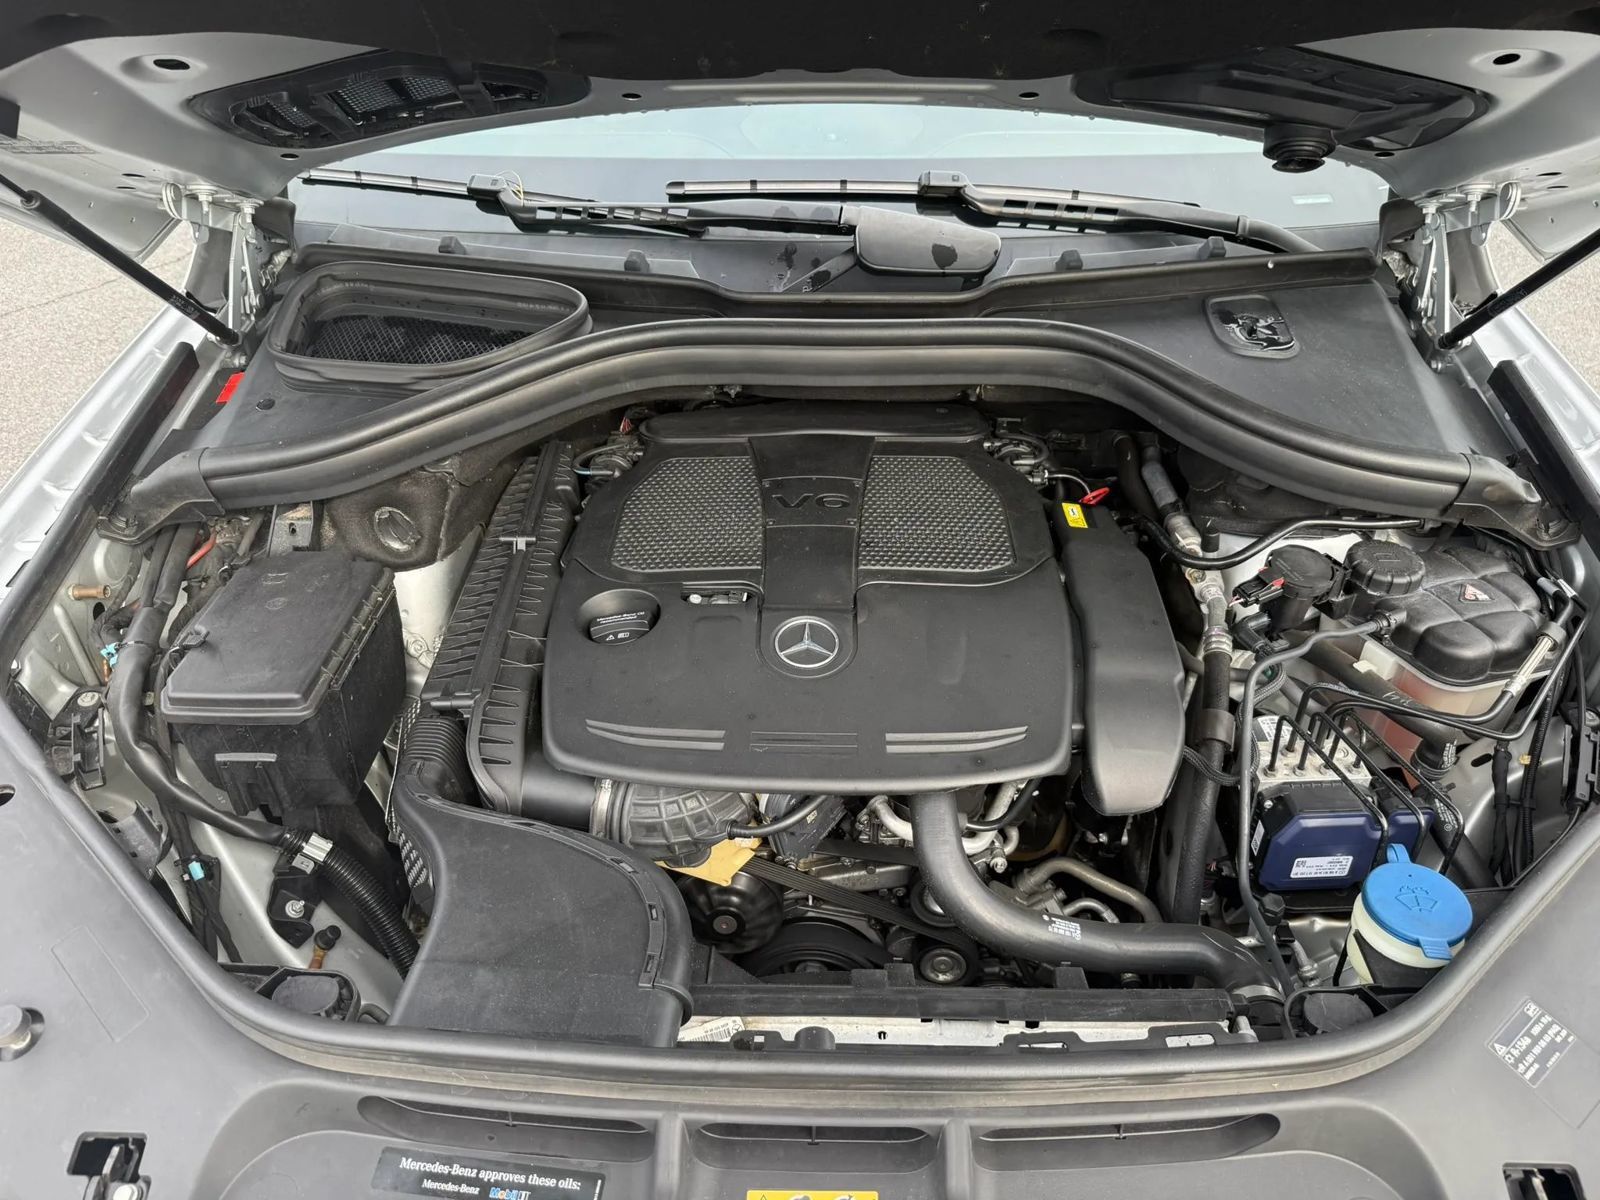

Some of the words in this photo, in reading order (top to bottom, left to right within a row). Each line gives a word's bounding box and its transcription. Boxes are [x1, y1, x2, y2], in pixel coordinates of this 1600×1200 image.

[771, 493, 850, 508] V6
[400, 1157, 478, 1177] Mercedes-Benz
[479, 1169, 526, 1183] approves
[528, 1173, 557, 1187] these
[558, 1178, 582, 1190] oils:
[422, 1179, 480, 1195] Mercedes-Benz
